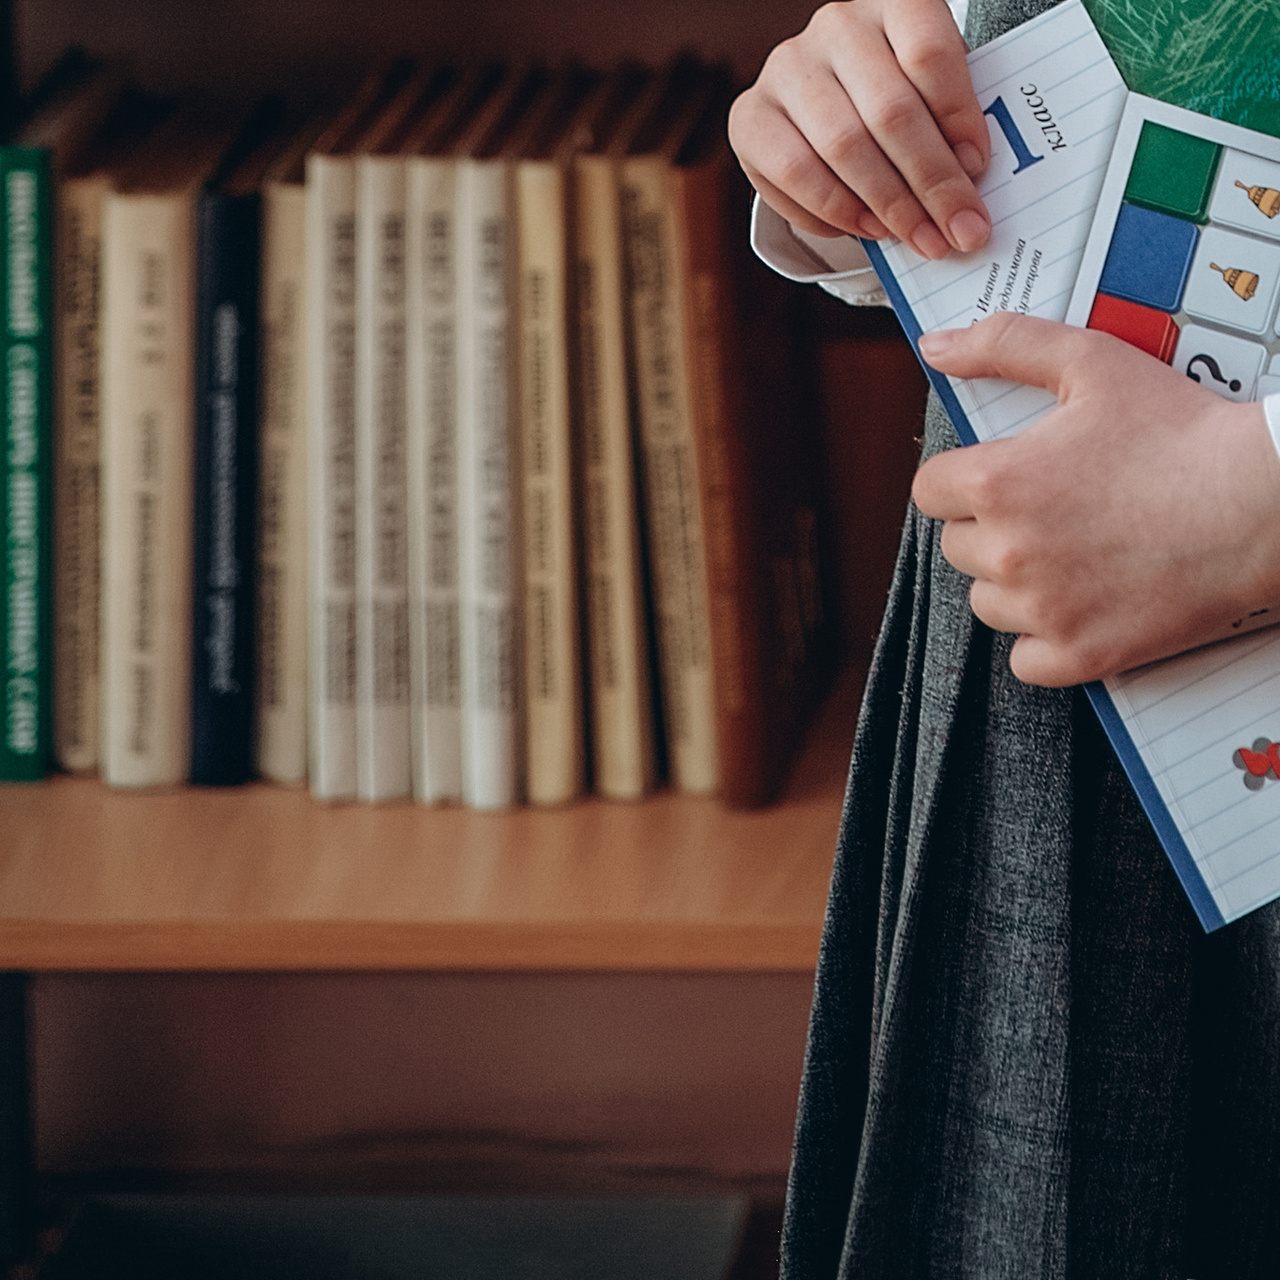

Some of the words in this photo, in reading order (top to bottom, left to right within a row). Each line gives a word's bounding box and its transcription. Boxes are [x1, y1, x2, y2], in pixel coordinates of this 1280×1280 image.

[983, 95, 1045, 175] 1
[1020, 83, 1068, 152] класс
[4, 170, 37, 335] ШКОЛЬНЫЙ
[976, 262, 1001, 313] Иванов
[5, 343, 37, 466] СЛОВАРЬ
[6, 471, 39, 676] ИНОСТРАННЫХ
